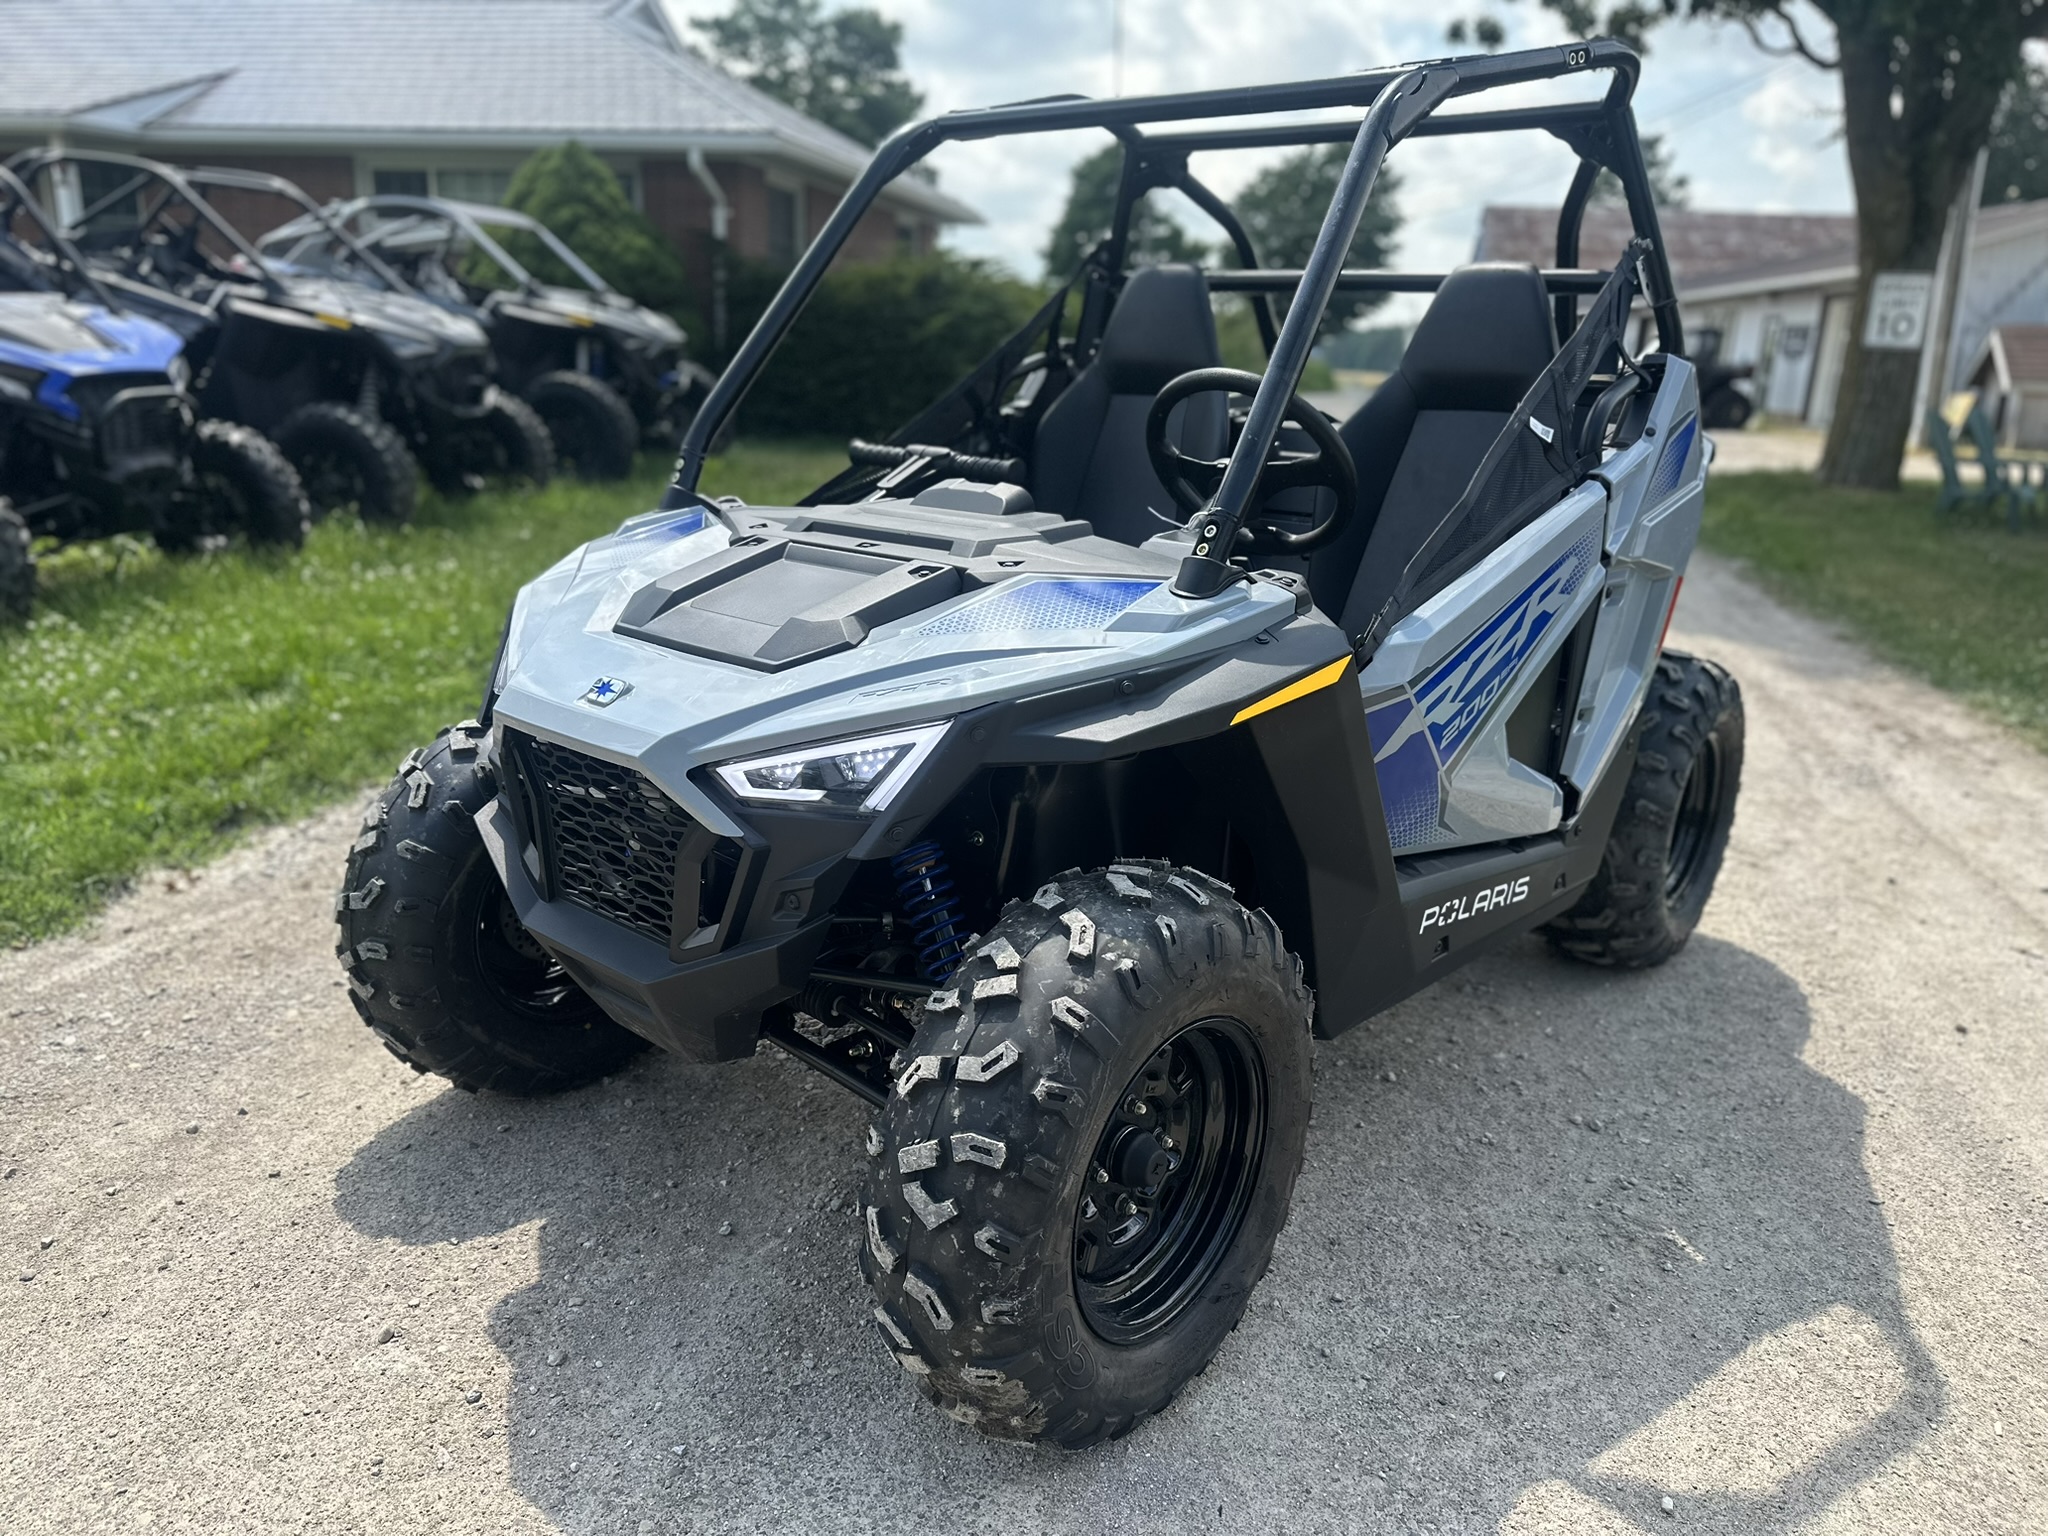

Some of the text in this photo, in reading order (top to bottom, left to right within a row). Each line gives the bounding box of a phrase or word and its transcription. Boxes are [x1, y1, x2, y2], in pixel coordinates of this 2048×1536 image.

[1875, 311, 1917, 341] 10
[1374, 556, 1579, 763] RZR
[1440, 674, 1501, 750] 200
[1419, 876, 1530, 934] POLARIS
